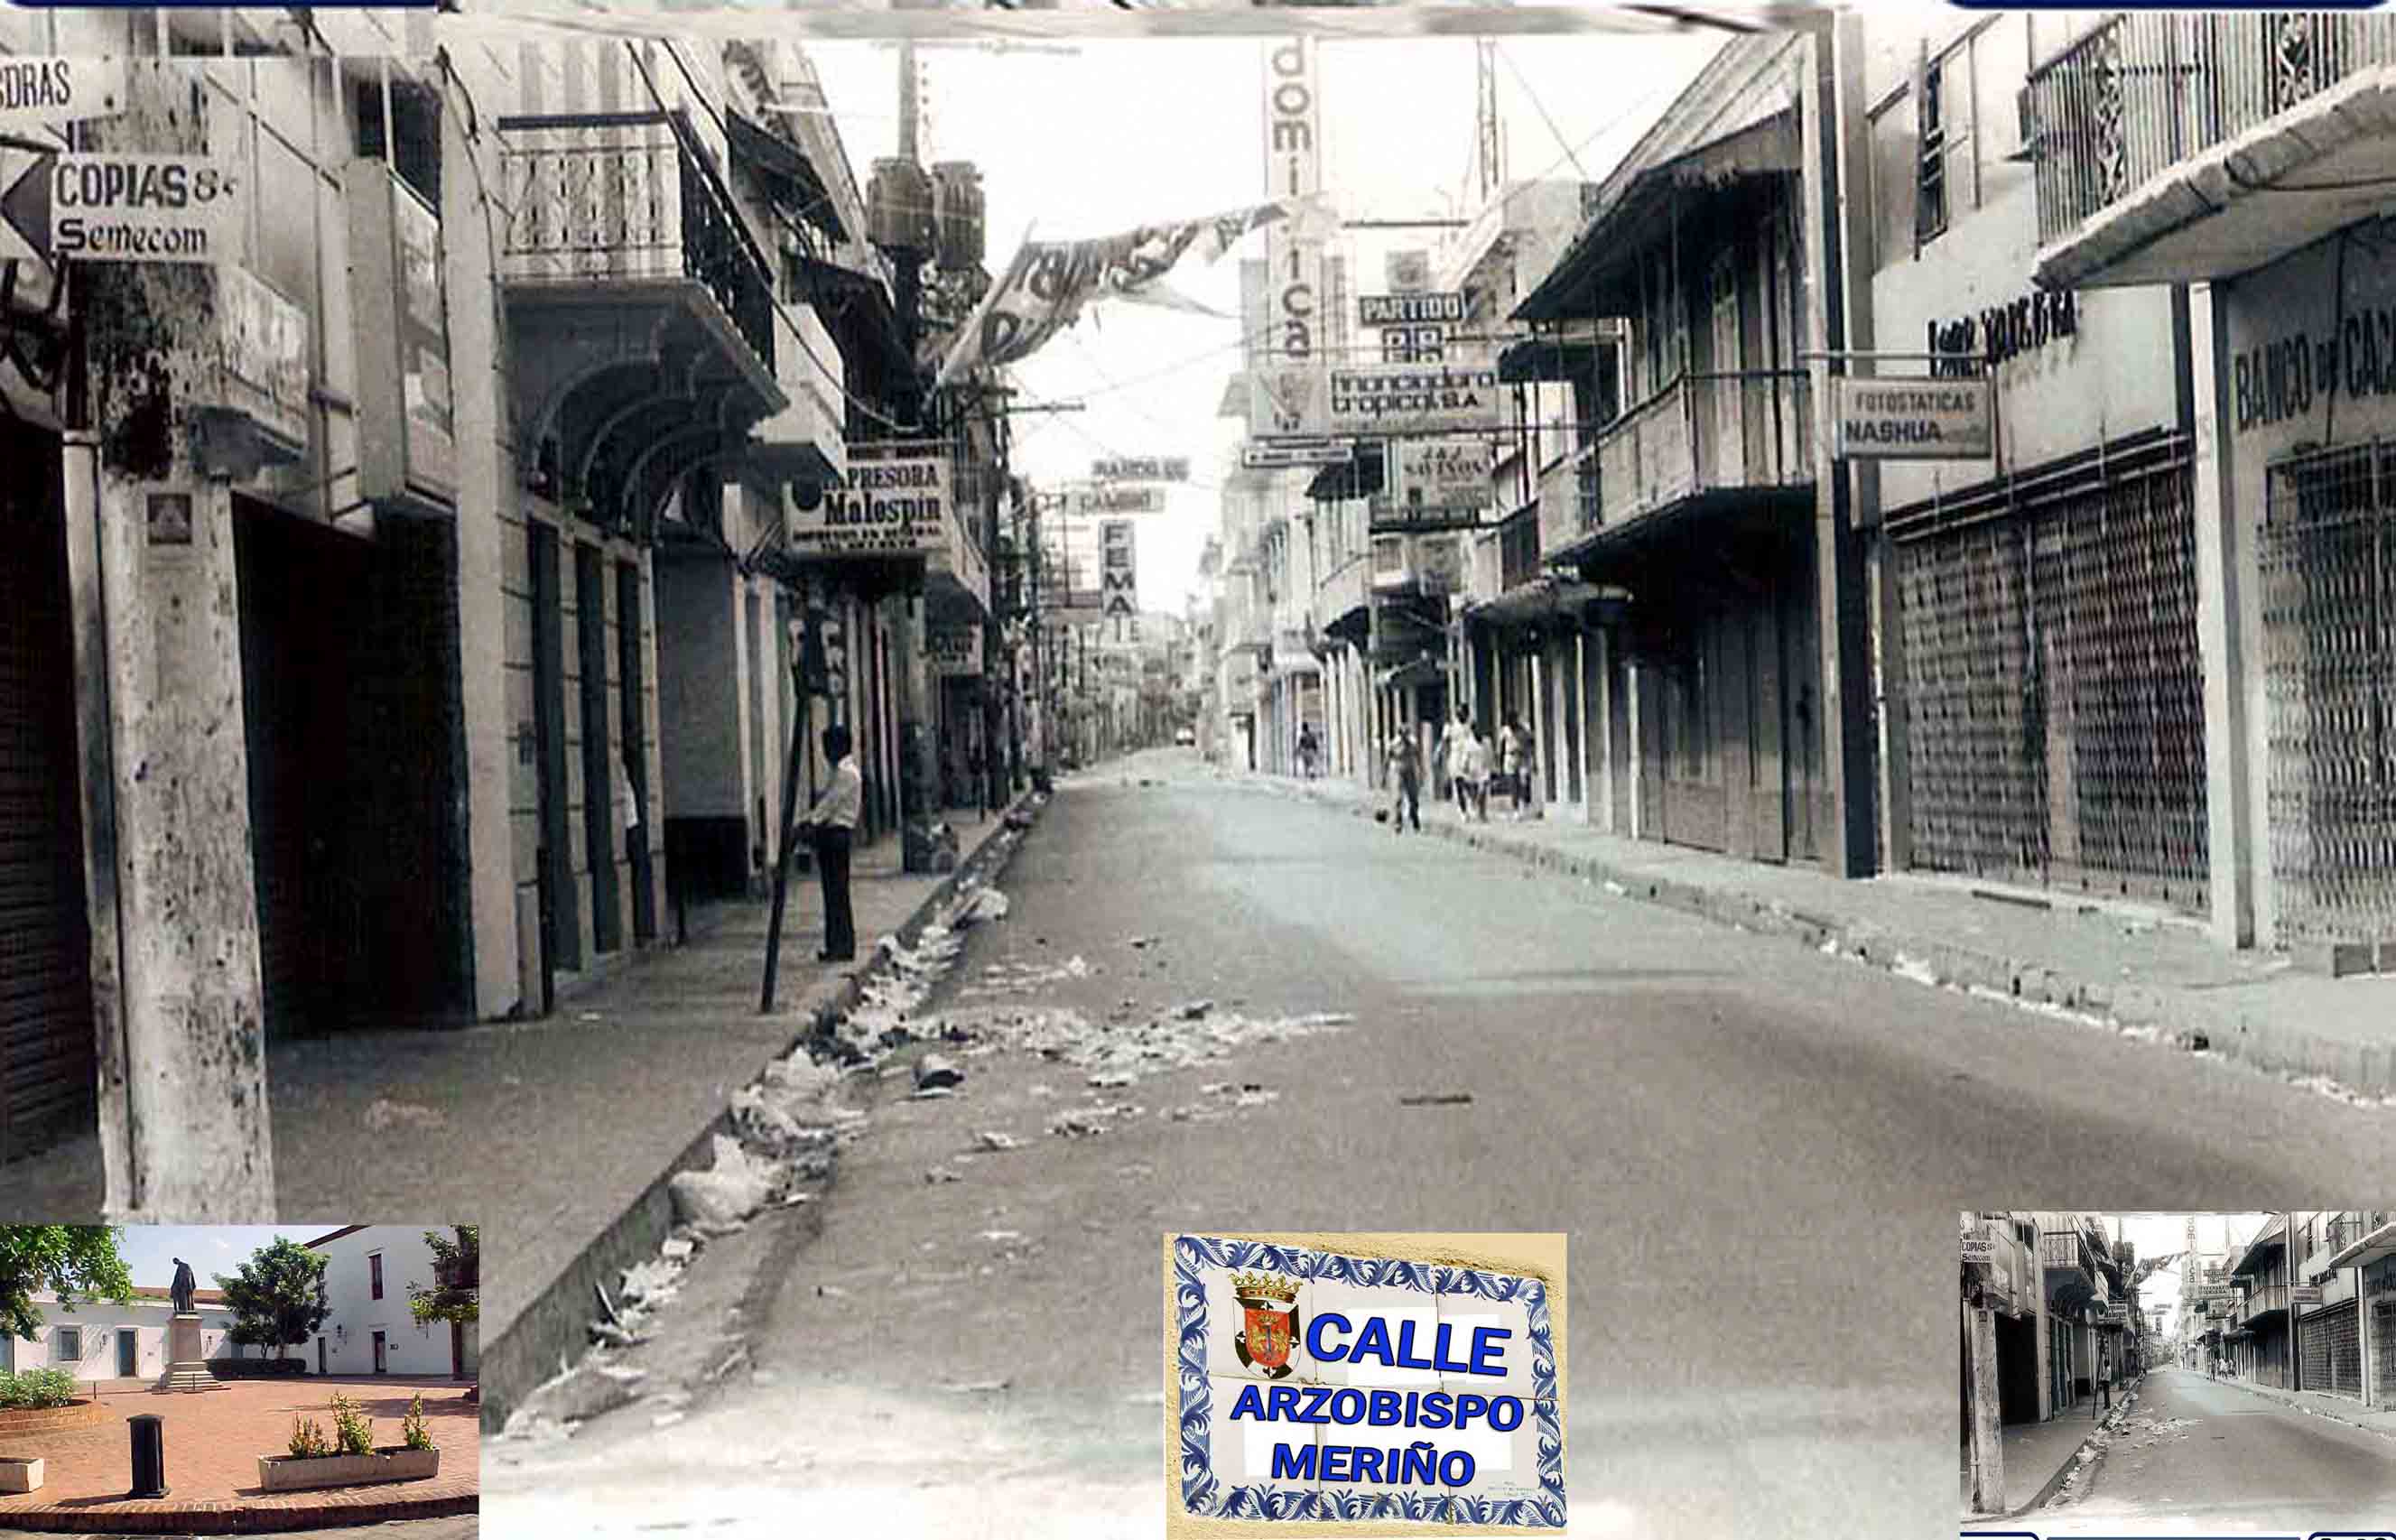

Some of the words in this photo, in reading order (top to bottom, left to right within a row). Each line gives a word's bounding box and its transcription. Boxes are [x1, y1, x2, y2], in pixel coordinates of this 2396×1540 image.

[0, 60, 70, 109] DRAS
[57, 164, 187, 208] COPIAS
[1856, 392, 1975, 413] FOTOSTATICAS
[2235, 333, 2312, 427] BANCO
[1845, 420, 1941, 444] NASHUA
[823, 463, 940, 491] PRESORA
[1305, 1313, 1512, 1377] CALLE
[1230, 1384, 1525, 1432] ARZOBISPO
[1271, 1441, 1476, 1488] MERIÑO
